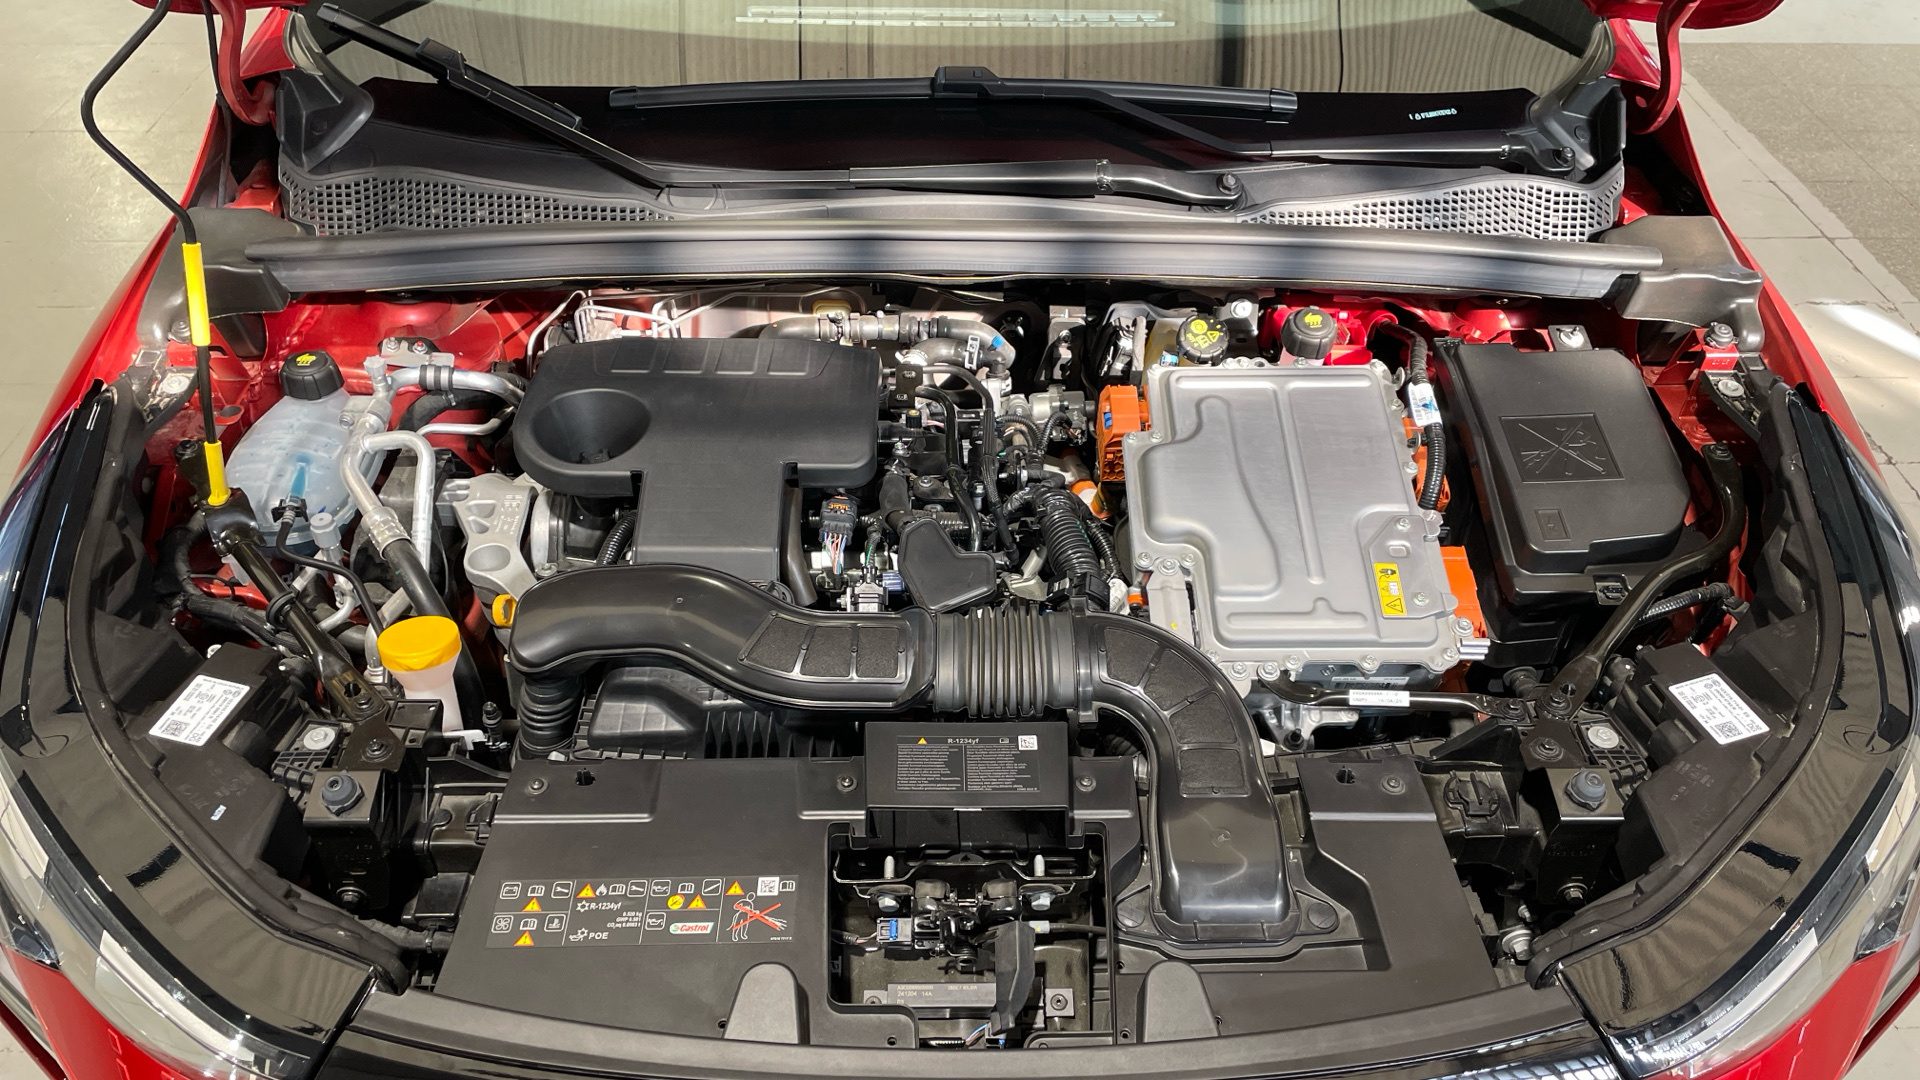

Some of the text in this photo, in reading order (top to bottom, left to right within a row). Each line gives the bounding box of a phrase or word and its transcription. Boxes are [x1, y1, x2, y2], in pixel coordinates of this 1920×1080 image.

[589, 902, 622, 911] R-1234yf
[680, 924, 709, 932] Castrol
[588, 932, 609, 940] POE
